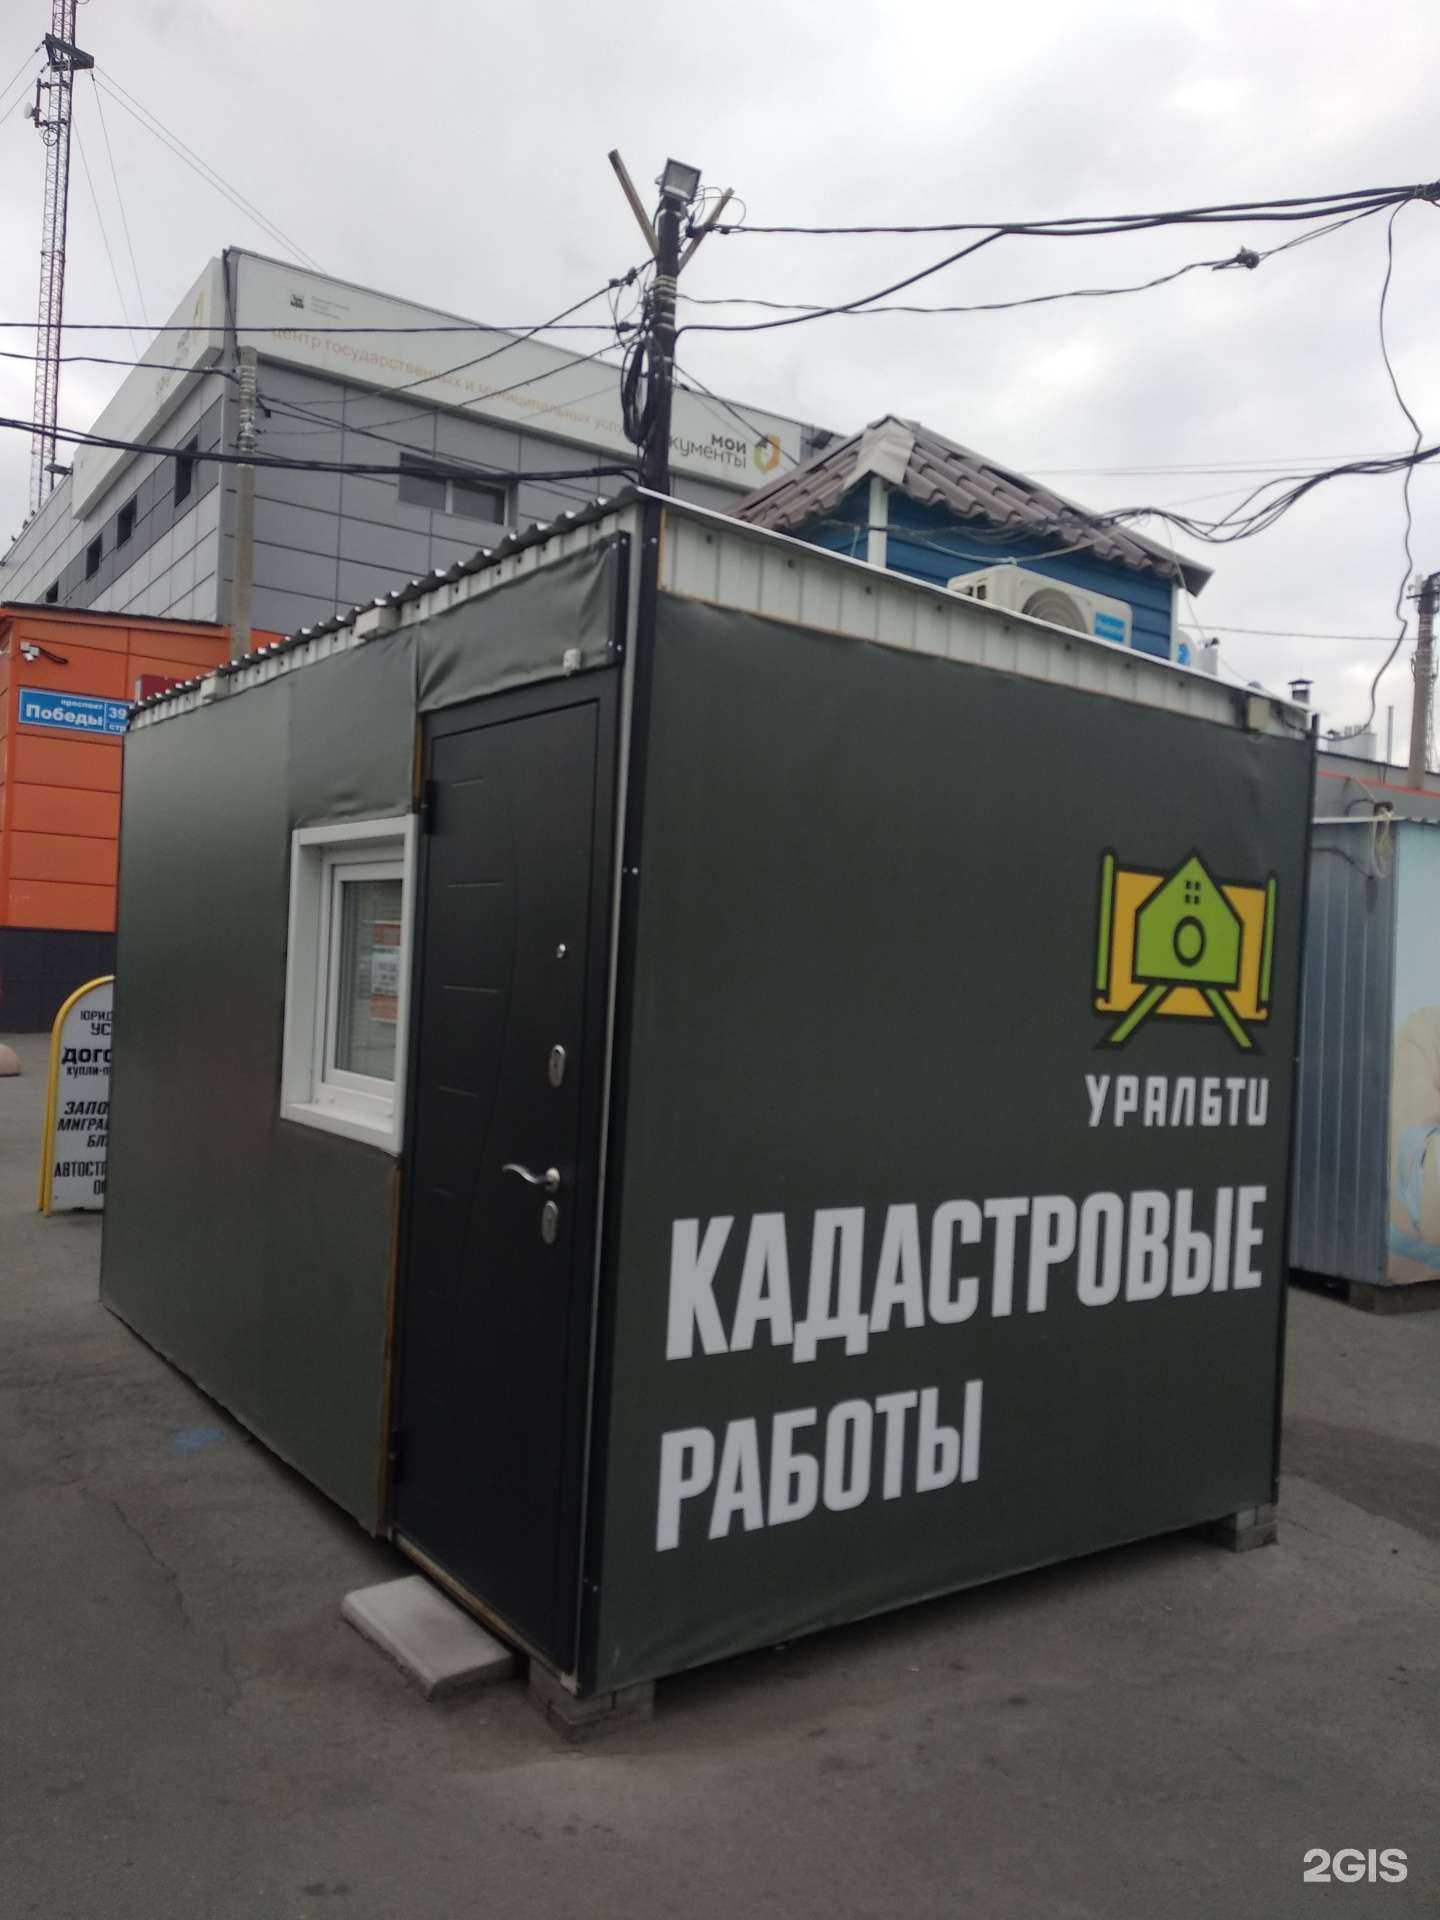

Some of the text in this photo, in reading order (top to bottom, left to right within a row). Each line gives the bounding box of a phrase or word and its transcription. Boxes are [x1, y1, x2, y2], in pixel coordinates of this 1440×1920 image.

[25, 703, 103, 727] Победы
[60, 699, 103, 710] проспект
[666, 1185, 1267, 1364] КАДАСТРОВЫЕ
[655, 1379, 984, 1553] РАБОТЫ
